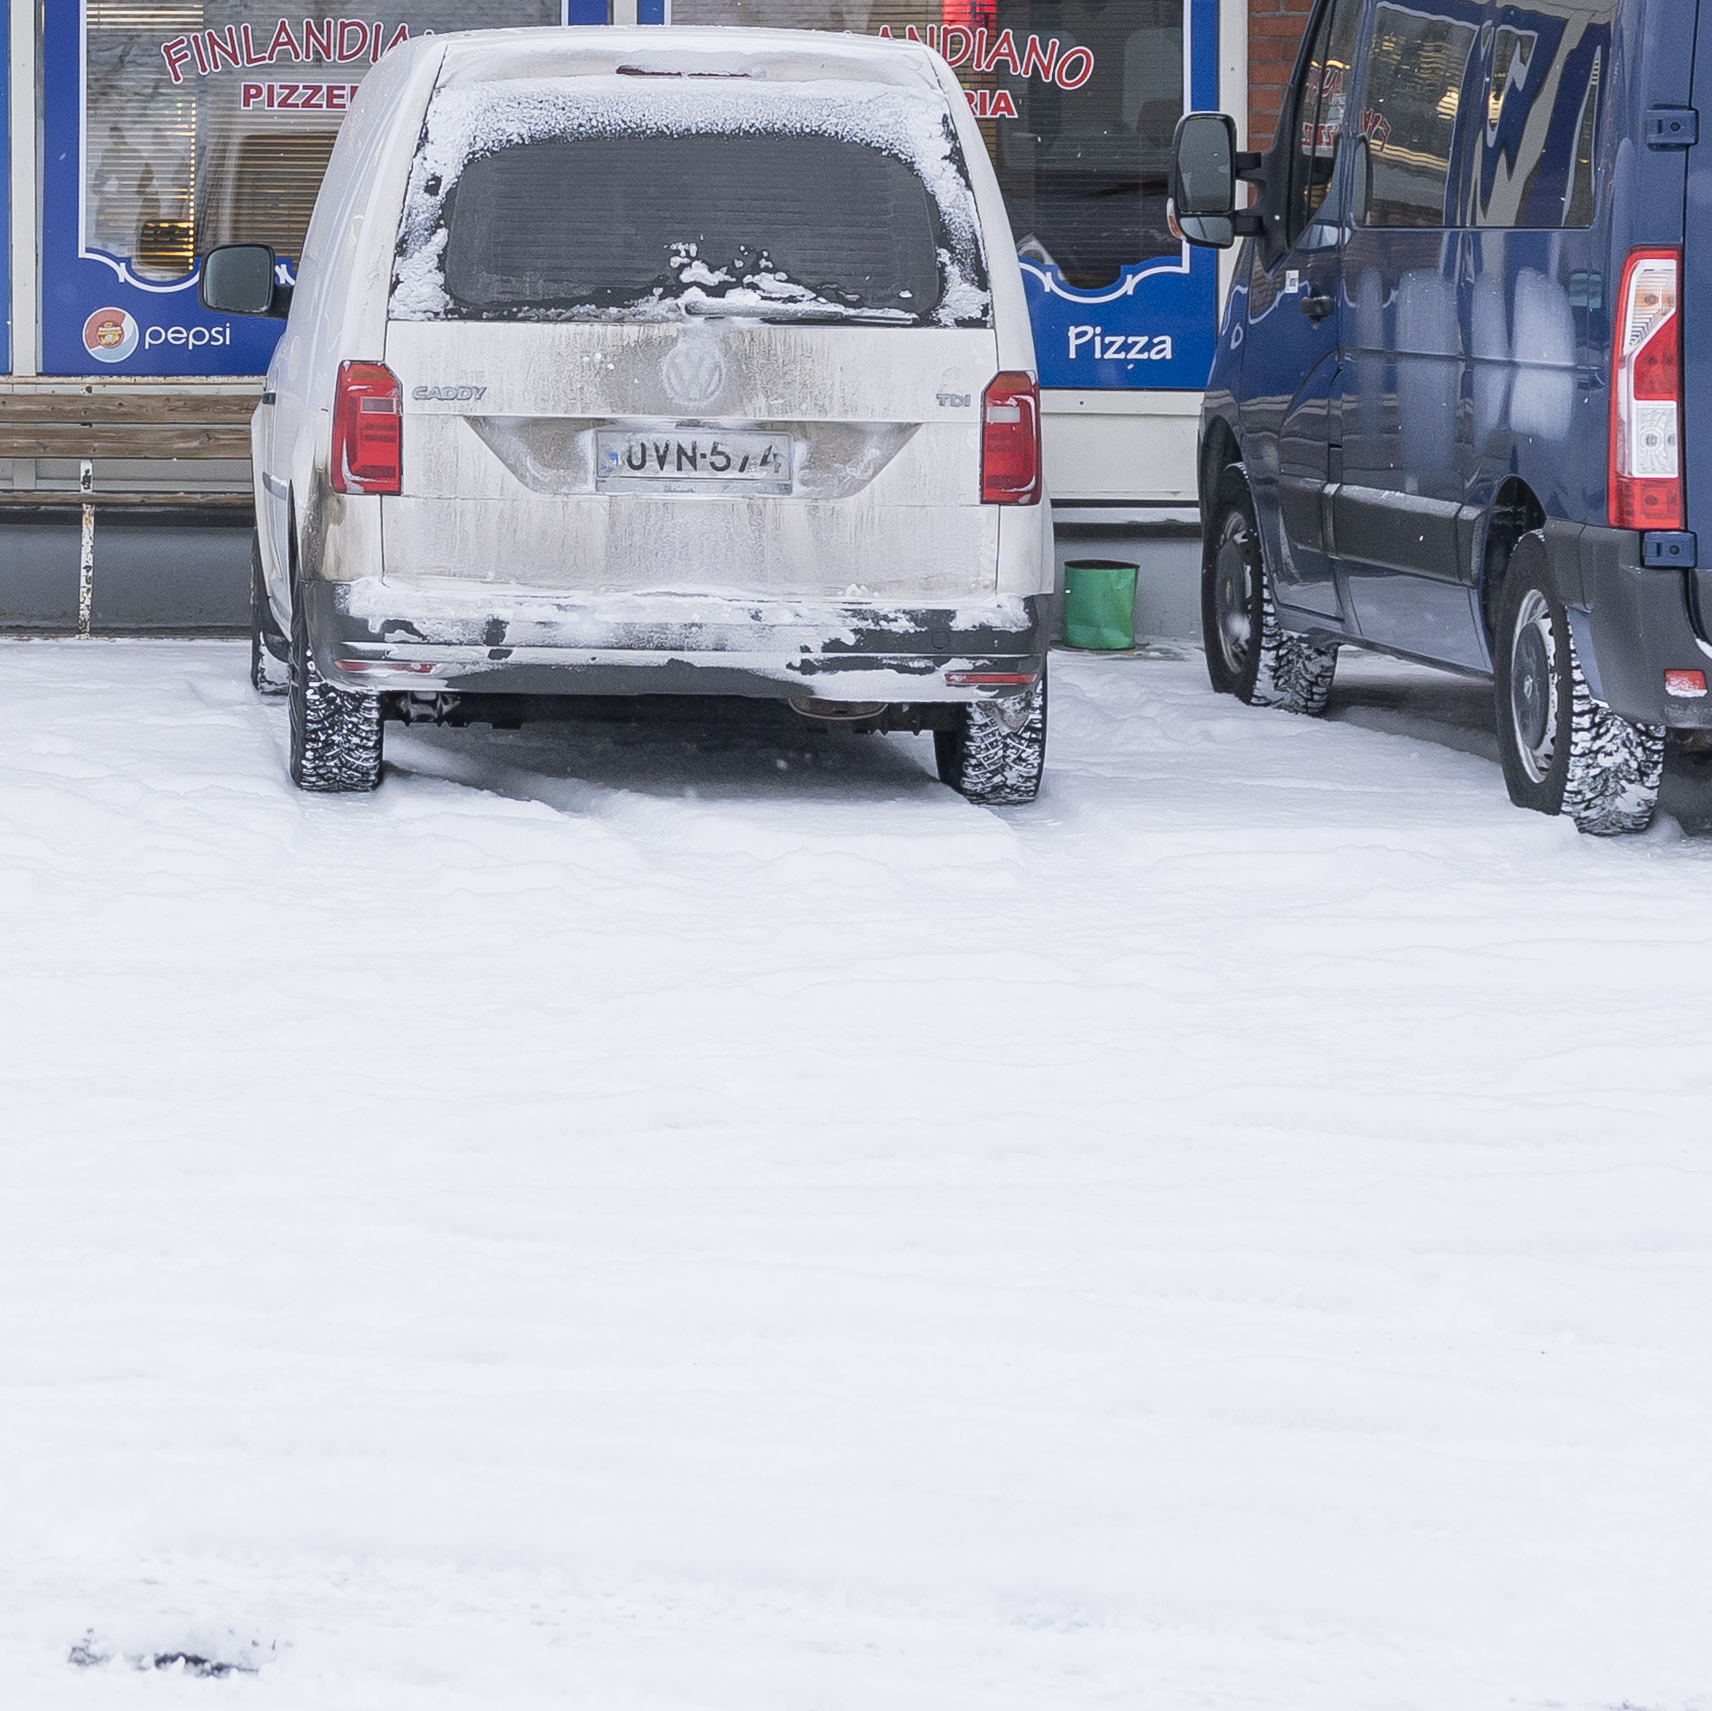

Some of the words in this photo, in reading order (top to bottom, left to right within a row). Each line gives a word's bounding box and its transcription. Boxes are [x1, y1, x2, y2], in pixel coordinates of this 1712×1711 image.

[162, 18, 433, 84] FINLANDIA
[242, 83, 361, 110] PIZZE
[144, 322, 231, 350] pepsi
[1068, 325, 1172, 361] Pizza
[411, 385, 488, 401] CADDY
[936, 393, 971, 408] TDI
